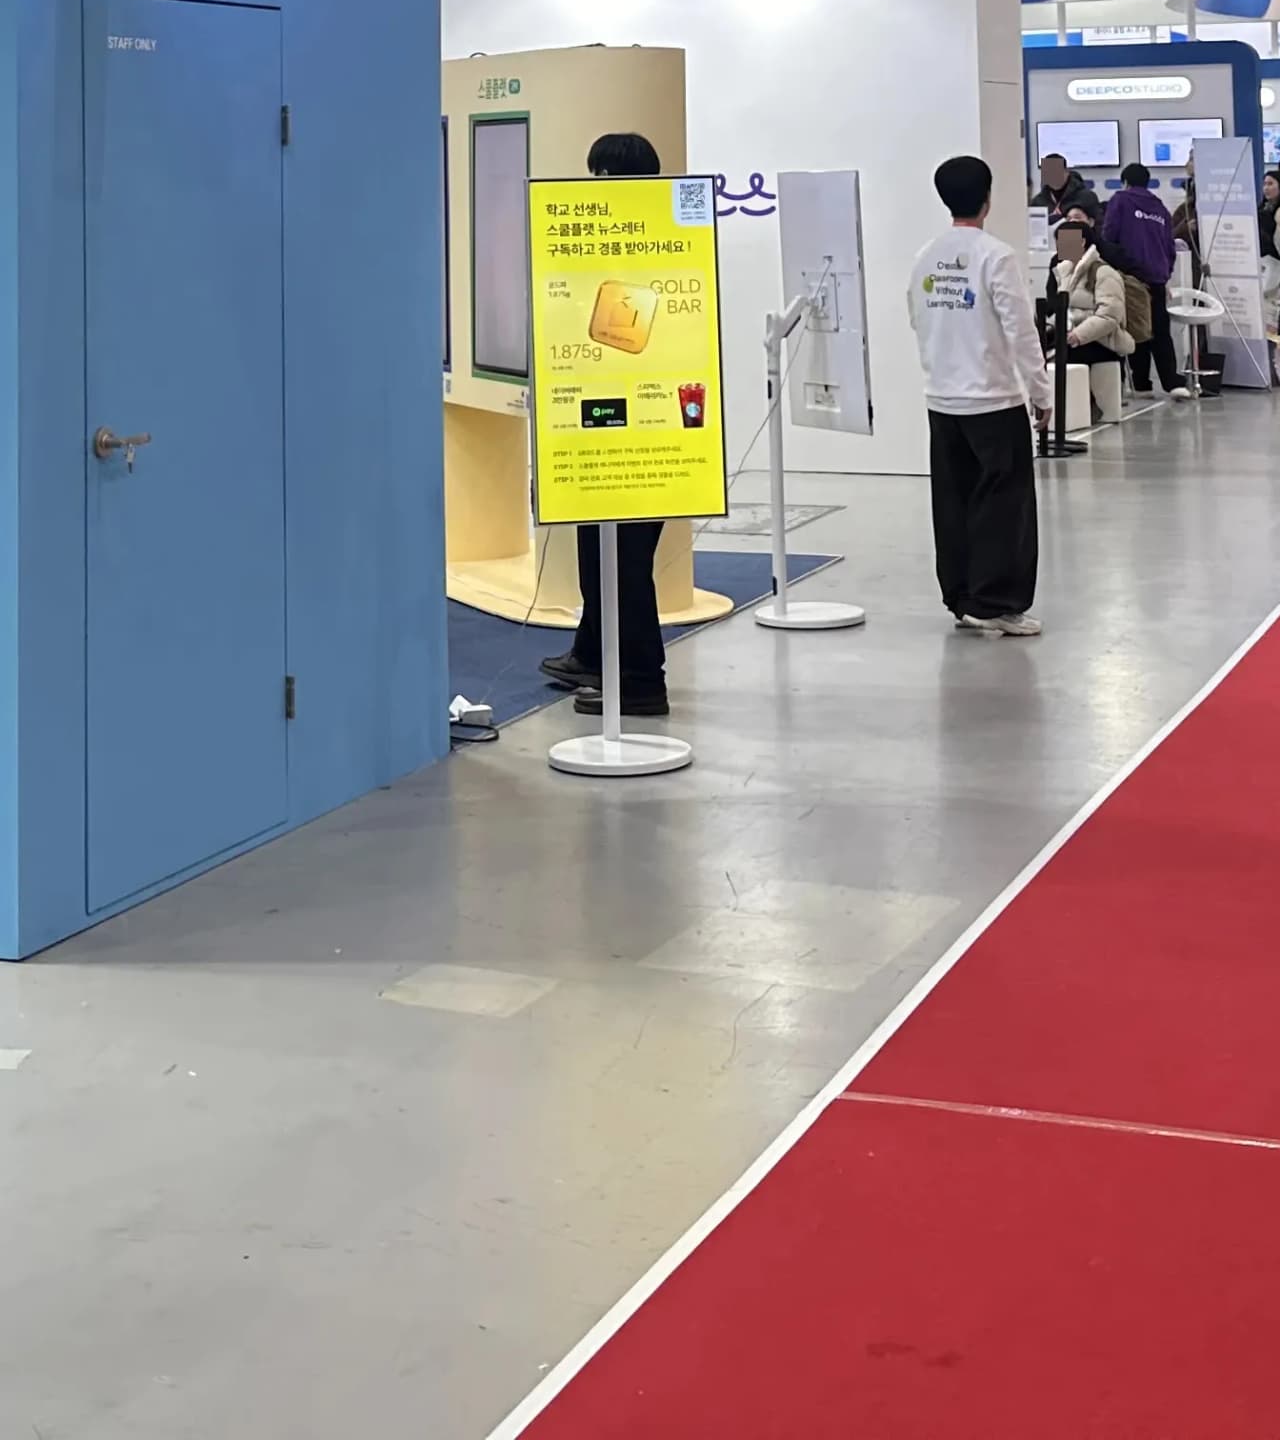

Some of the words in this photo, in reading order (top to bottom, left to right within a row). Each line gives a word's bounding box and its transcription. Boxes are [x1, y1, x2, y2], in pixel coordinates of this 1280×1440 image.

[107, 35, 133, 49] STAFF
[134, 38, 157, 51] ONLY
[477, 77, 508, 100] 스쿨플랫
[546, 203, 570, 218] 학교
[573, 202, 613, 218] 선생님,
[546, 222, 595, 237] 스쿨플랫
[598, 221, 646, 235] 뉴스레터
[547, 242, 595, 257] 구독하고
[599, 241, 621, 255] 경품
[625, 240, 684, 255] 받아가세요
[649, 278, 702, 295] GOLD
[666, 299, 702, 314] BAR
[550, 344, 603, 362] 1.875g
